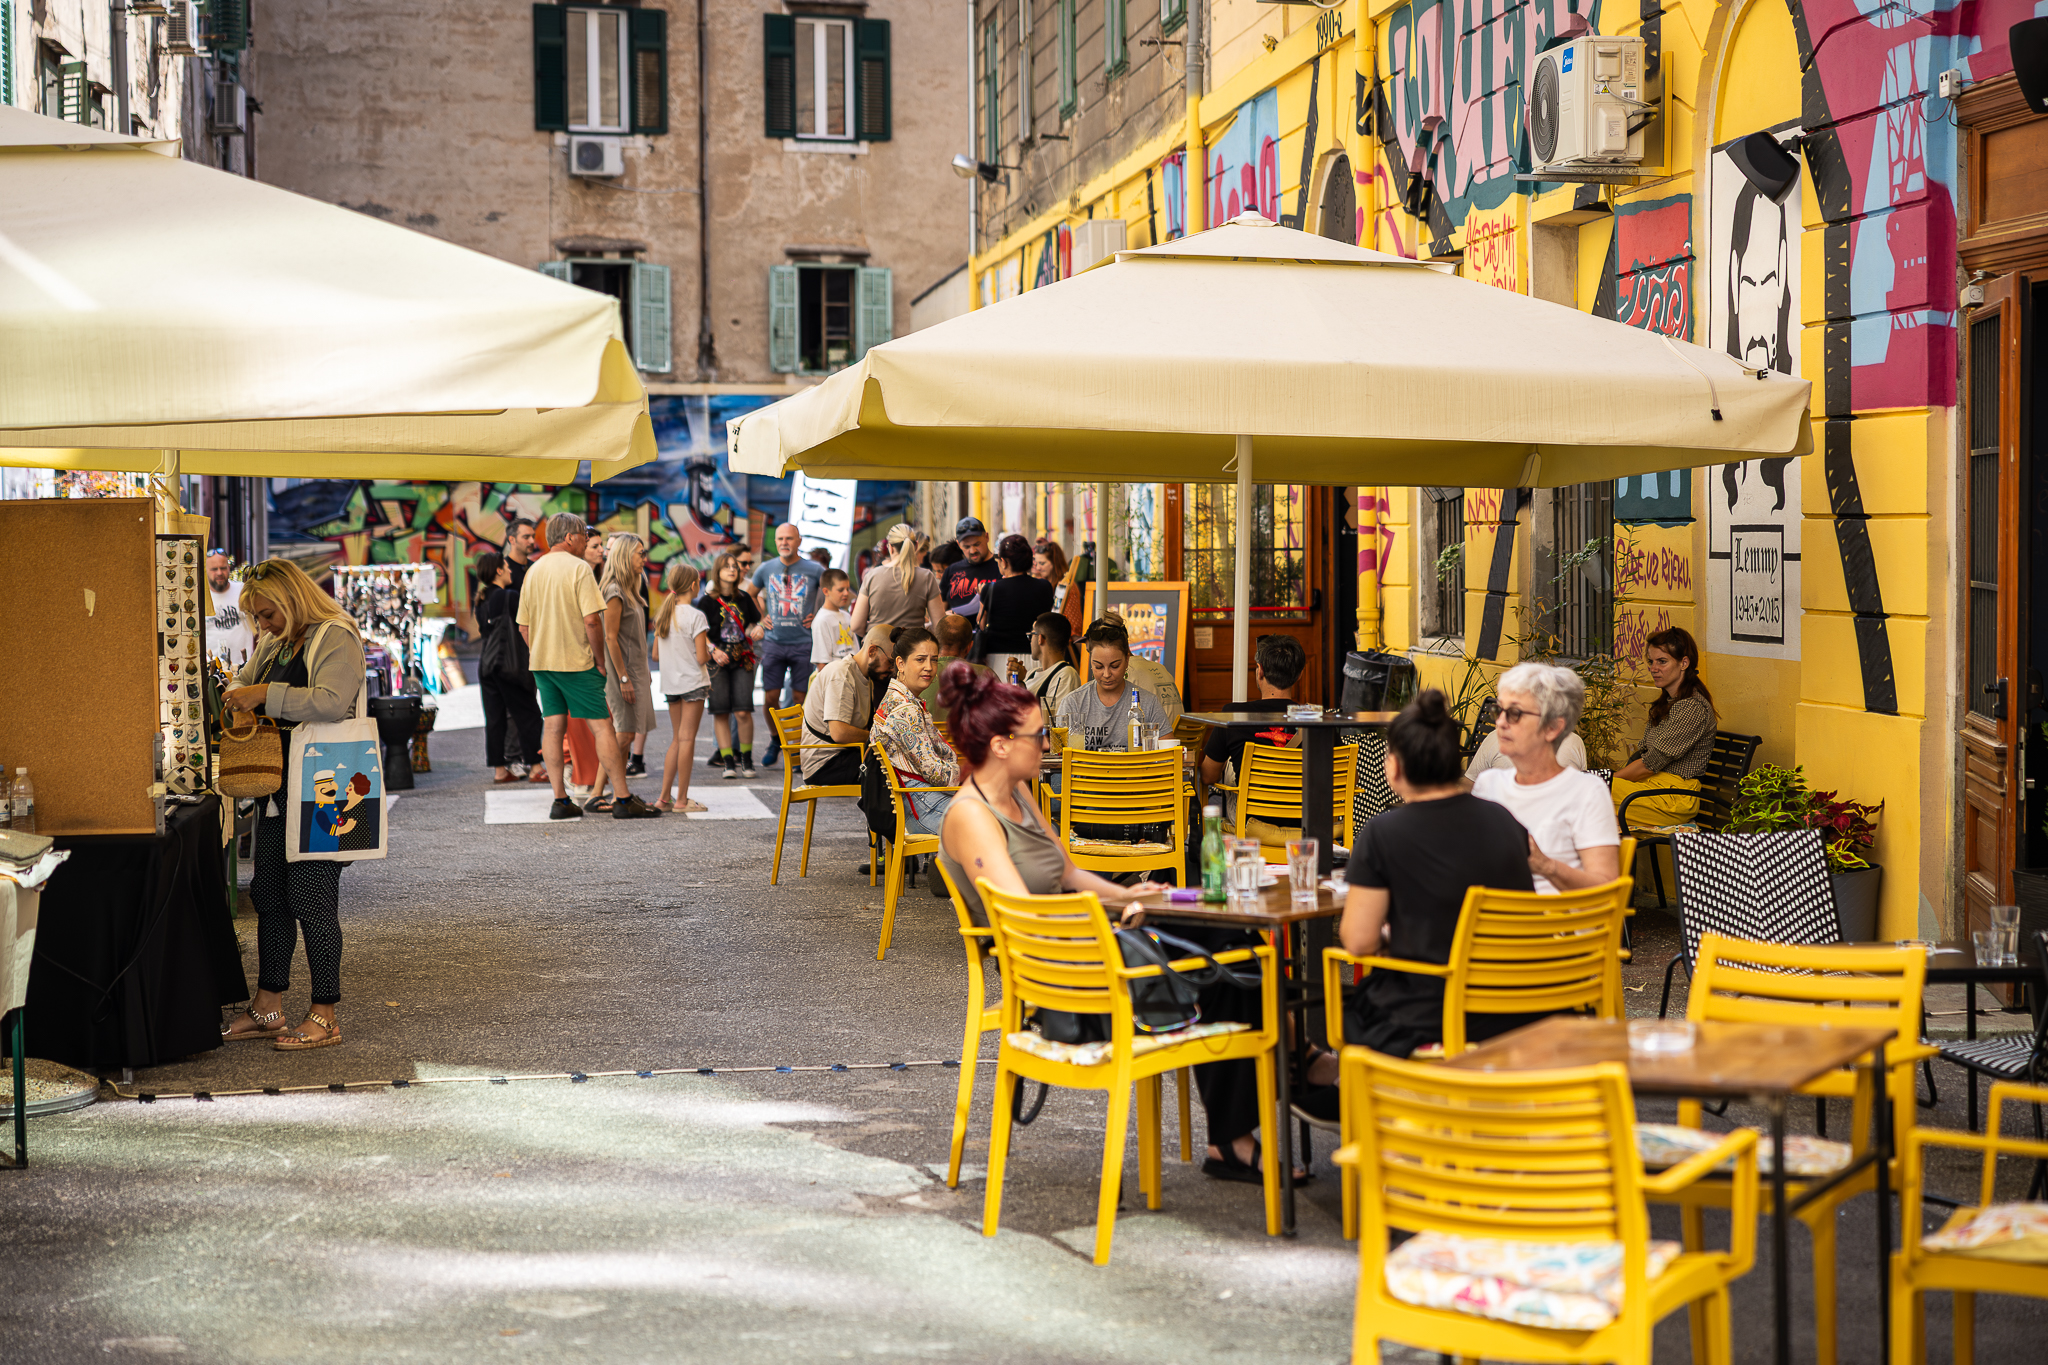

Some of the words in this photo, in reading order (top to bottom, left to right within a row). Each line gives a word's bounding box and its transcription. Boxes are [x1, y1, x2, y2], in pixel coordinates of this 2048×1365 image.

[1735, 537, 1779, 584] Lemmy
[1084, 726, 1109, 737] CAME
[1084, 735, 1104, 746] SAW
